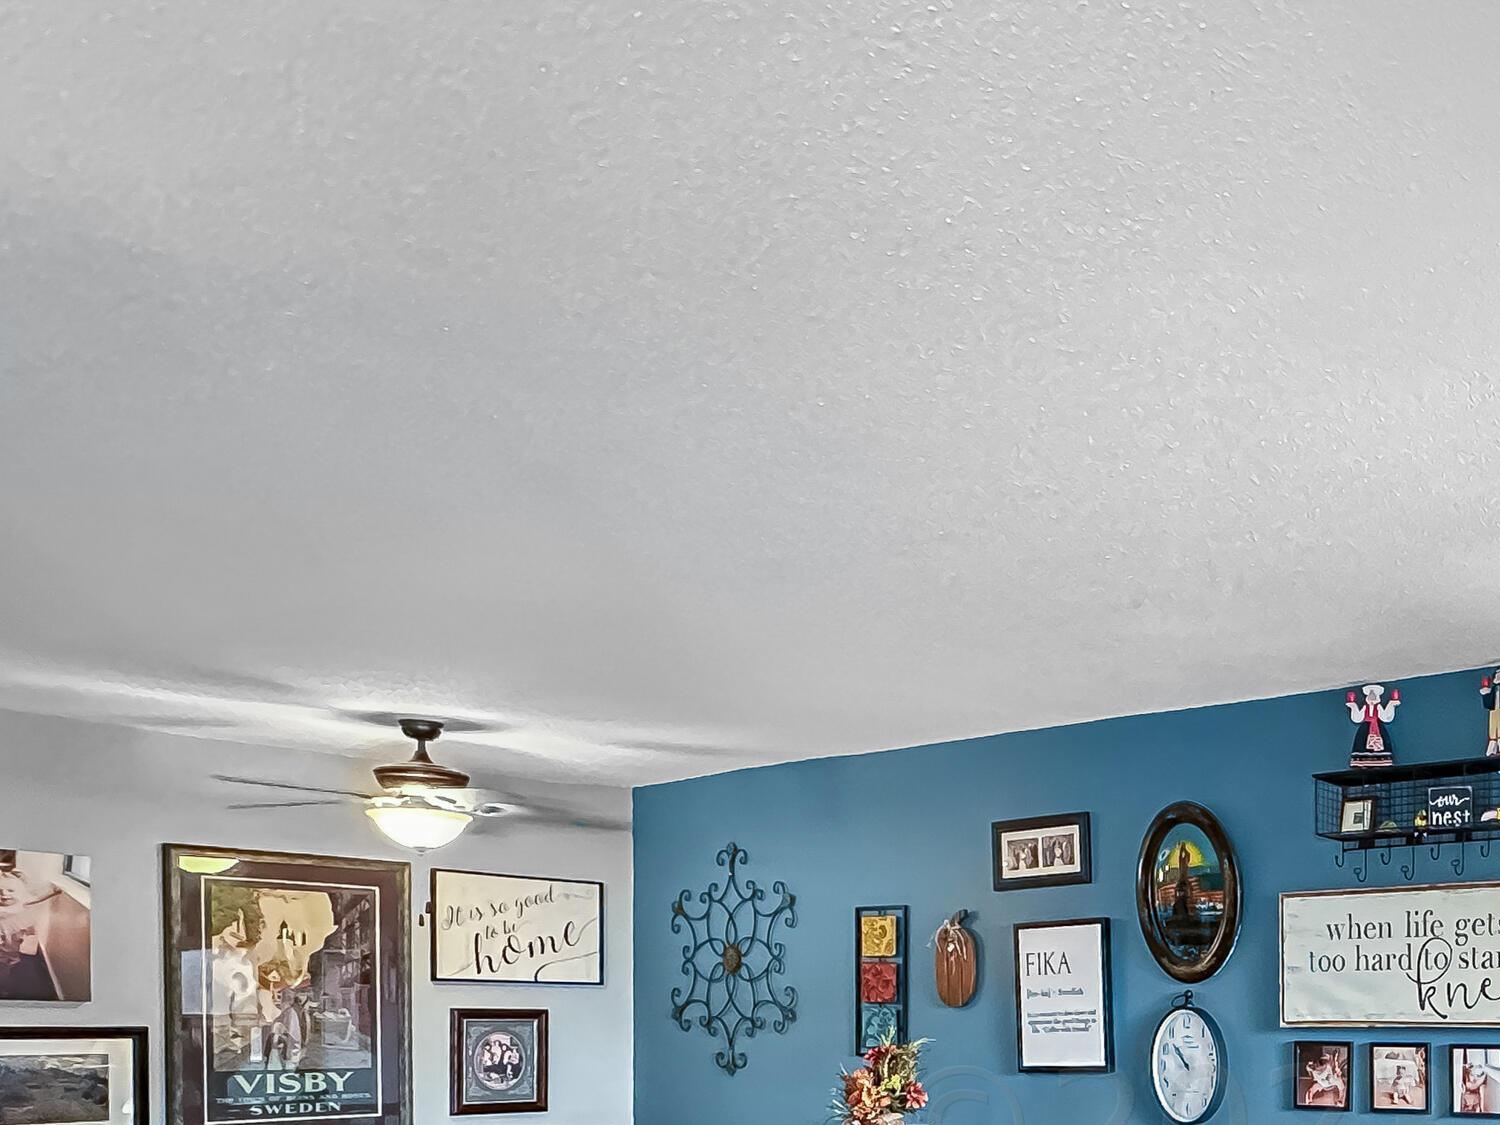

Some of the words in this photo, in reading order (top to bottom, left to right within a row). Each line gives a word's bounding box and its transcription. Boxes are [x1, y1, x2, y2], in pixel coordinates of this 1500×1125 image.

[1431, 794, 1470, 807] our
[1432, 810, 1470, 827] nest
[514, 884, 557, 918] good
[1327, 913, 1392, 940] when
[1404, 909, 1444, 938] life
[473, 920, 597, 976] home
[1309, 951, 1346, 972] too
[1355, 943, 1412, 971] hard
[1424, 949, 1450, 971] to
[1026, 951, 1071, 976] FIKA
[233, 1072, 354, 1095] VISBY
[250, 1101, 342, 1116] SWEDEN
